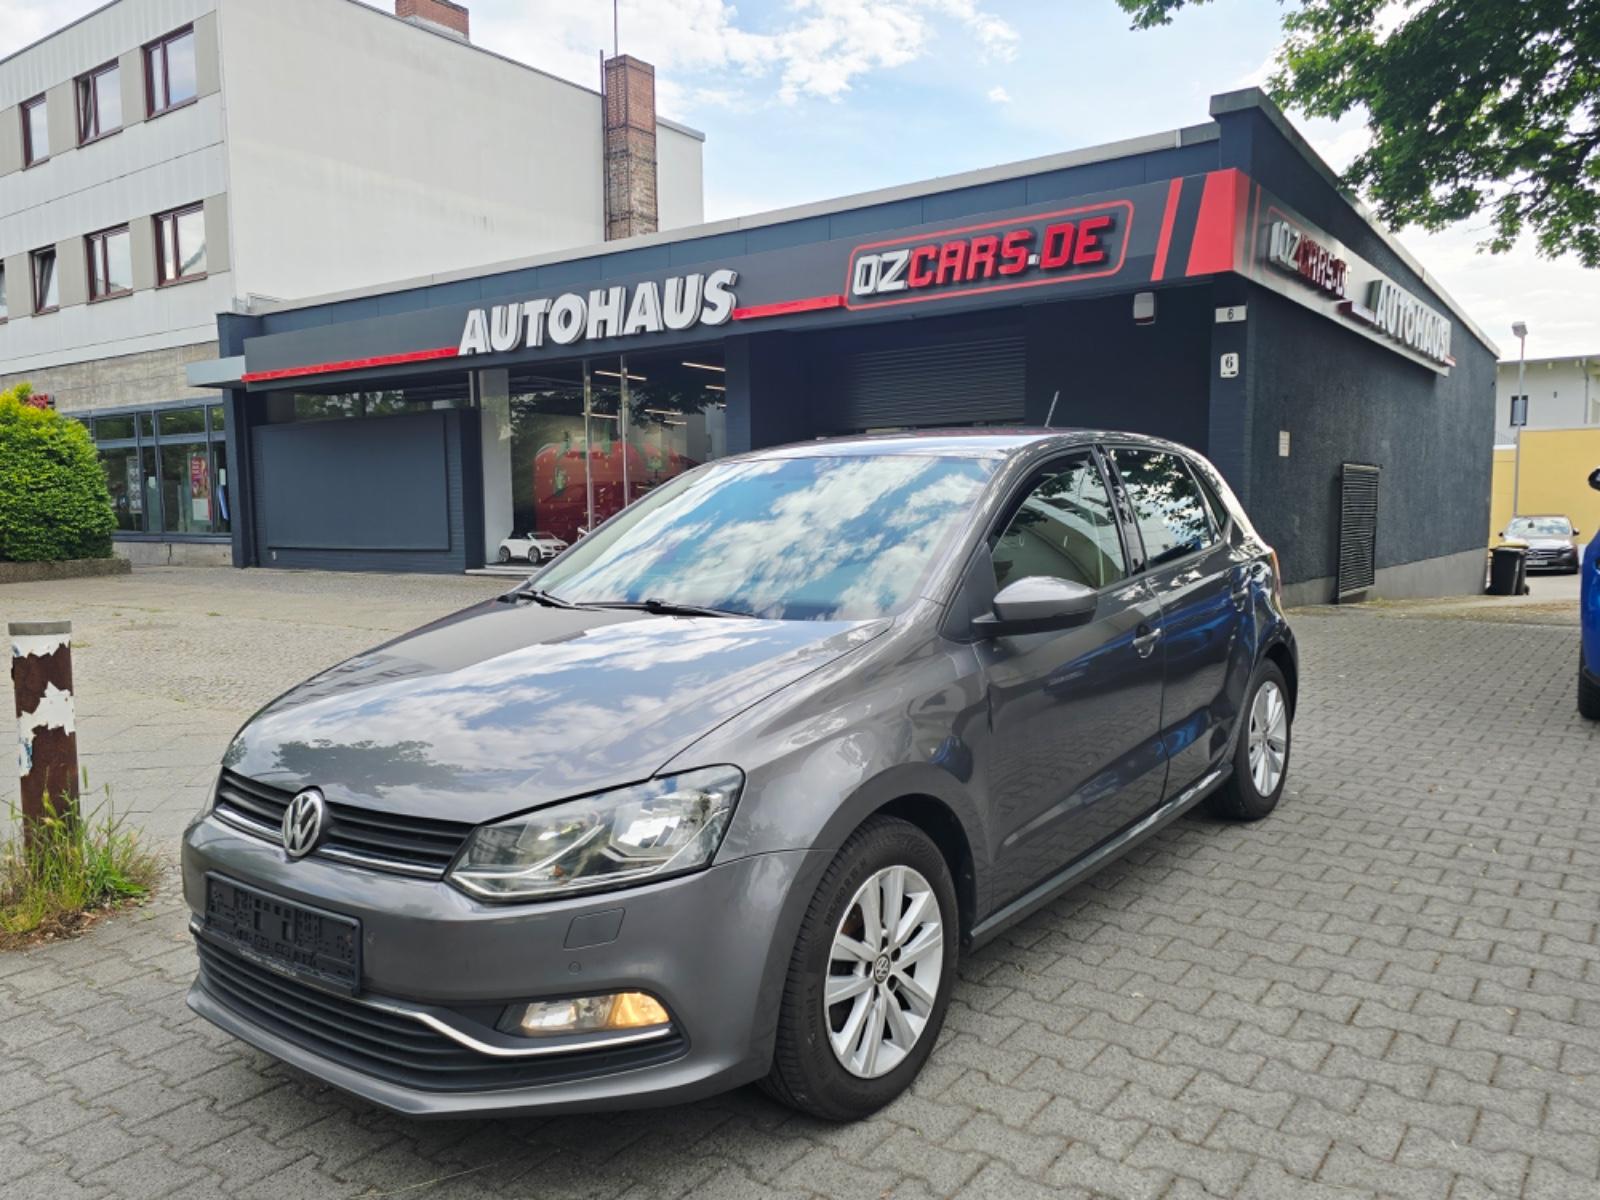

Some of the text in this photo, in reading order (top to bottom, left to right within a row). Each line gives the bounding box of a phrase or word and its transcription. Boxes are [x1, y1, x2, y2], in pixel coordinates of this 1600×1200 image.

[458, 215, 1111, 356] AUTOHAUS OZCARS.DE
[1375, 280, 1450, 362] AUTOHAUS
[1225, 355, 1233, 368] 6
